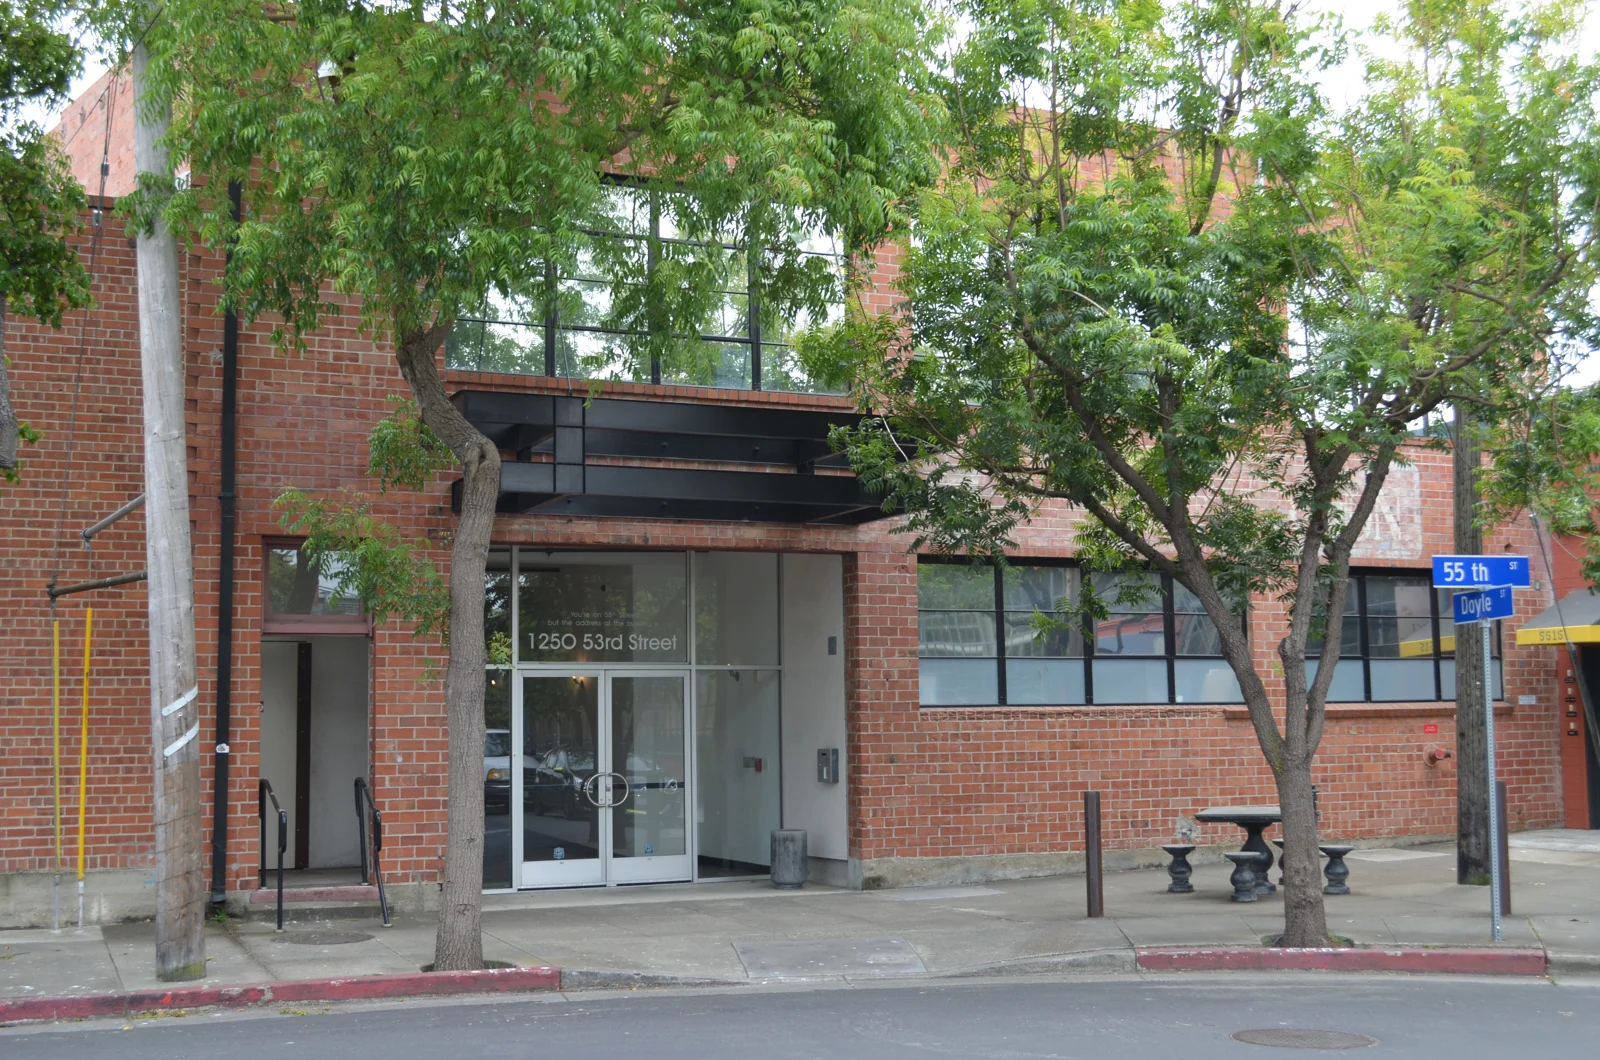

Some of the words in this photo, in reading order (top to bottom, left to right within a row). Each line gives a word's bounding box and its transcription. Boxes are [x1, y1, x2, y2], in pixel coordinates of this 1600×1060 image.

[1443, 561, 1465, 582] 55
[1471, 562, 1489, 582] th
[1509, 561, 1517, 570] ST
[1461, 594, 1492, 617] Doyle
[1499, 589, 1506, 598] ST
[528, 632, 577, 650] 1250
[582, 633, 623, 650] 53rd
[628, 633, 678, 651] Street
[1539, 630, 1564, 641] 5515
